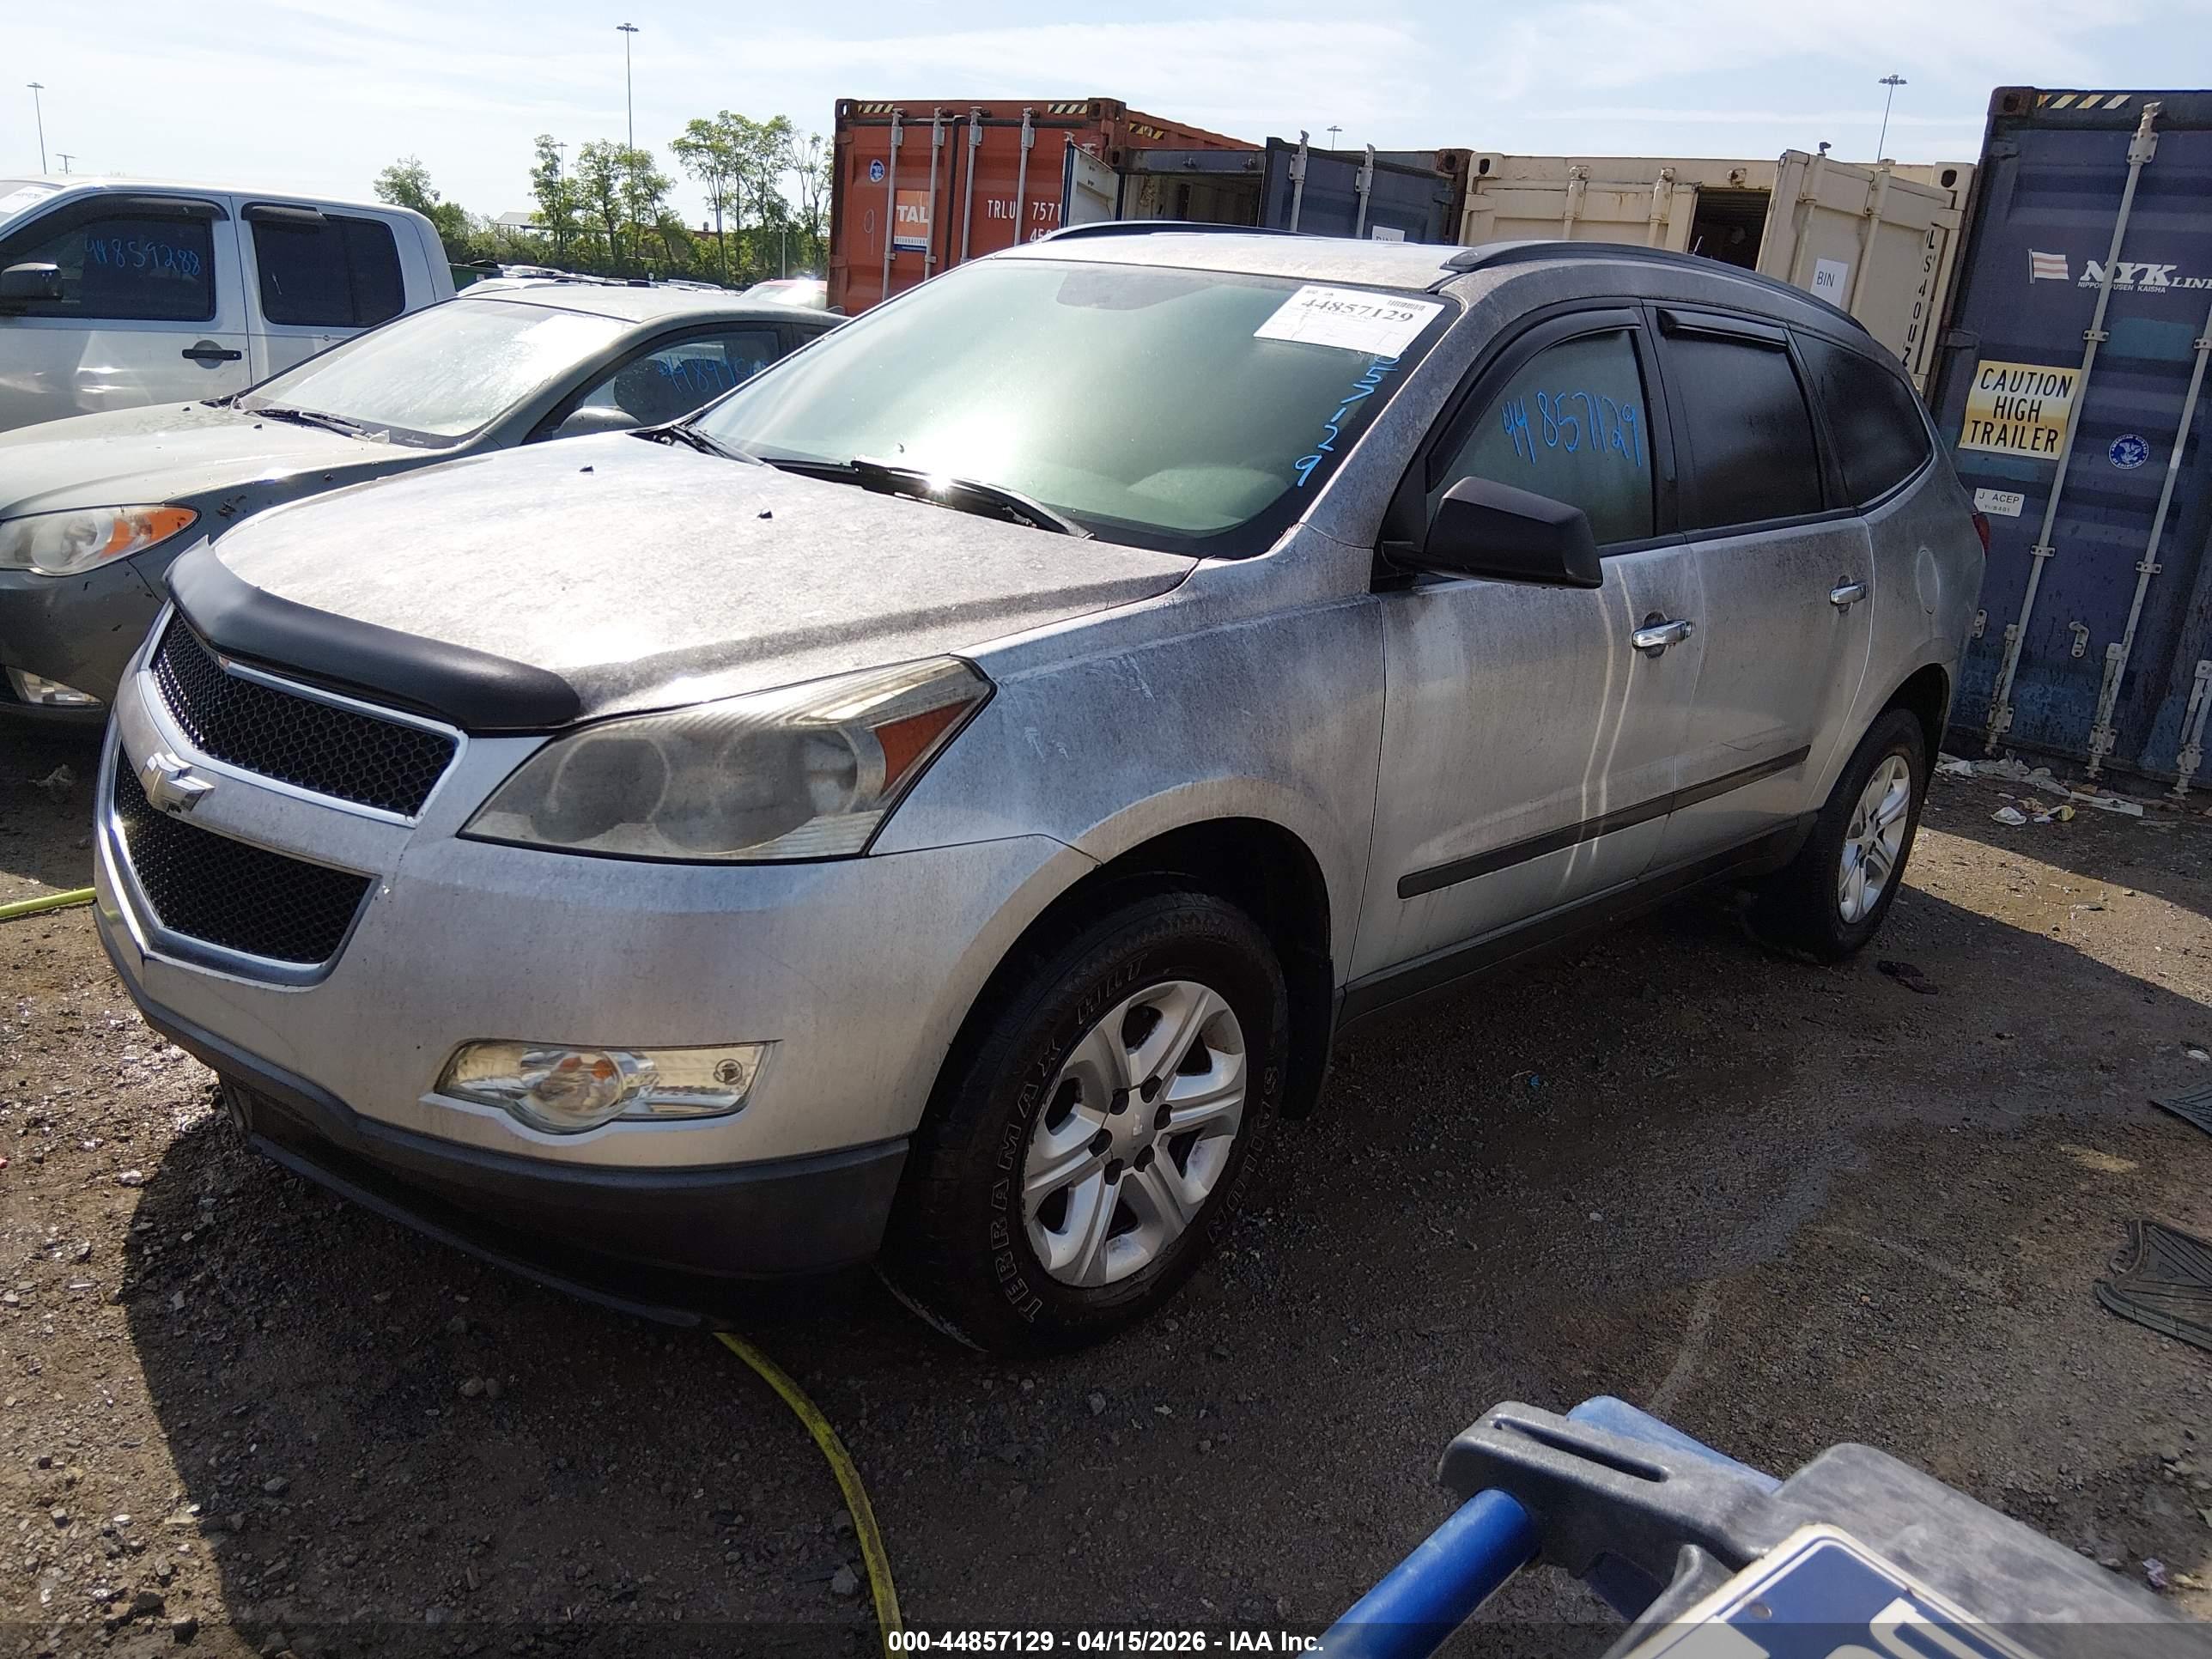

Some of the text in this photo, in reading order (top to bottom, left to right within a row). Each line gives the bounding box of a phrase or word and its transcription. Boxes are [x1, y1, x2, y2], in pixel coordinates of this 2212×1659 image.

[896, 205, 930, 223] TAL
[988, 199, 1017, 219] TRLU
[1816, 270, 1835, 288] BIN
[2080, 260, 2179, 287] NYK
[2137, 285, 2166, 294] KAISHA
[1301, 298, 1414, 323] 44857129
[1980, 368, 2073, 398] CAUTION
[1993, 395, 2043, 423] HIGH
[1970, 420, 2059, 453] TRAILER
[1992, 493, 2020, 504] ACEP
[989, 1037, 1062, 1324] TERRAMAX
